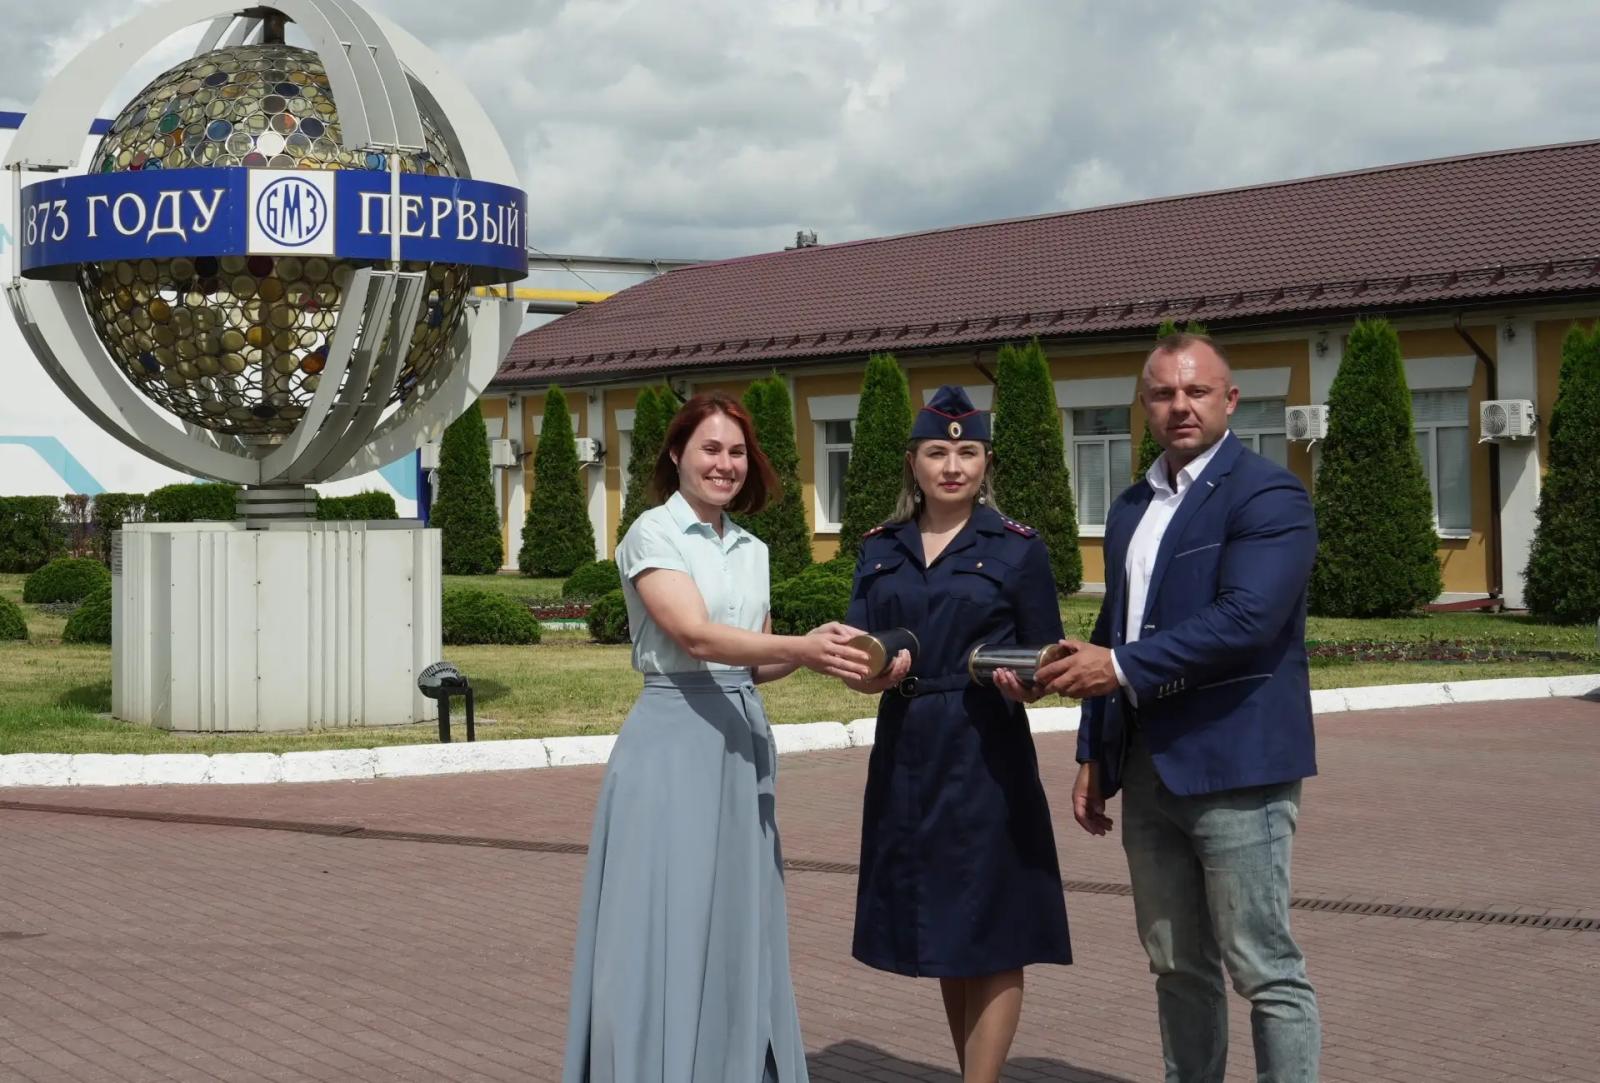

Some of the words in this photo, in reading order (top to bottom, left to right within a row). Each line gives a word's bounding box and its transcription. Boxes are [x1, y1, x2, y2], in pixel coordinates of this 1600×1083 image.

[23, 199, 69, 247] 1873
[87, 188, 226, 243] ГОДУ
[265, 183, 317, 240] БМЗ
[357, 191, 519, 248] ПЕРВЫЙ
